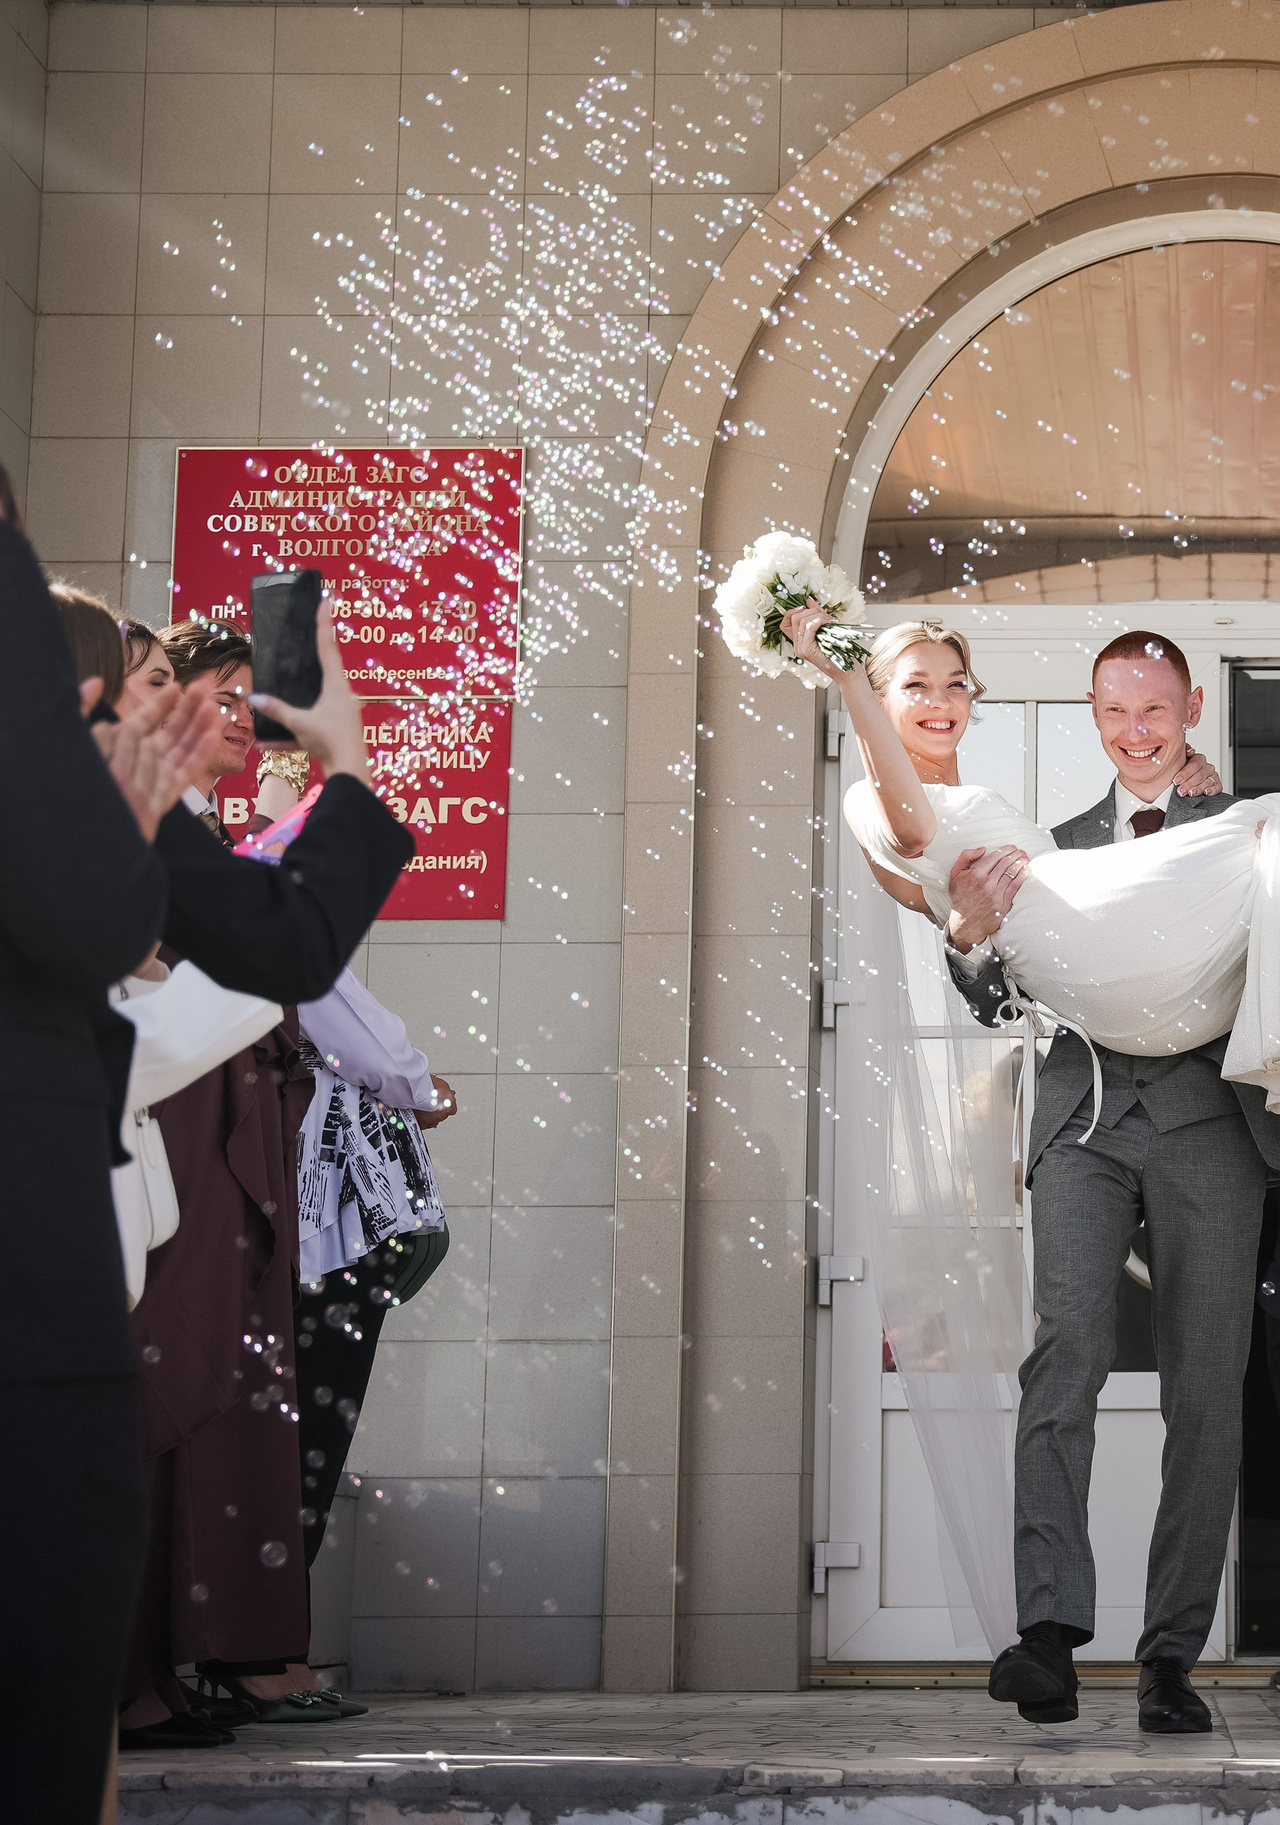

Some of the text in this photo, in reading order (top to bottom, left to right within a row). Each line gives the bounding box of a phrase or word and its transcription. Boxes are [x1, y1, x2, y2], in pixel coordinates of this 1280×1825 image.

[274, 466, 426, 487] ОТДЕЛ ЗАГС
[207, 514, 376, 533] СОВЕТСКОГО
[252, 544, 268, 557] г.
[211, 605, 236, 619] ПН
[419, 601, 477, 619] 17-30
[418, 625, 476, 644] 14-00
[362, 725, 492, 747] ДЕЛЬНИКА
[386, 797, 488, 824] ЗАГС
